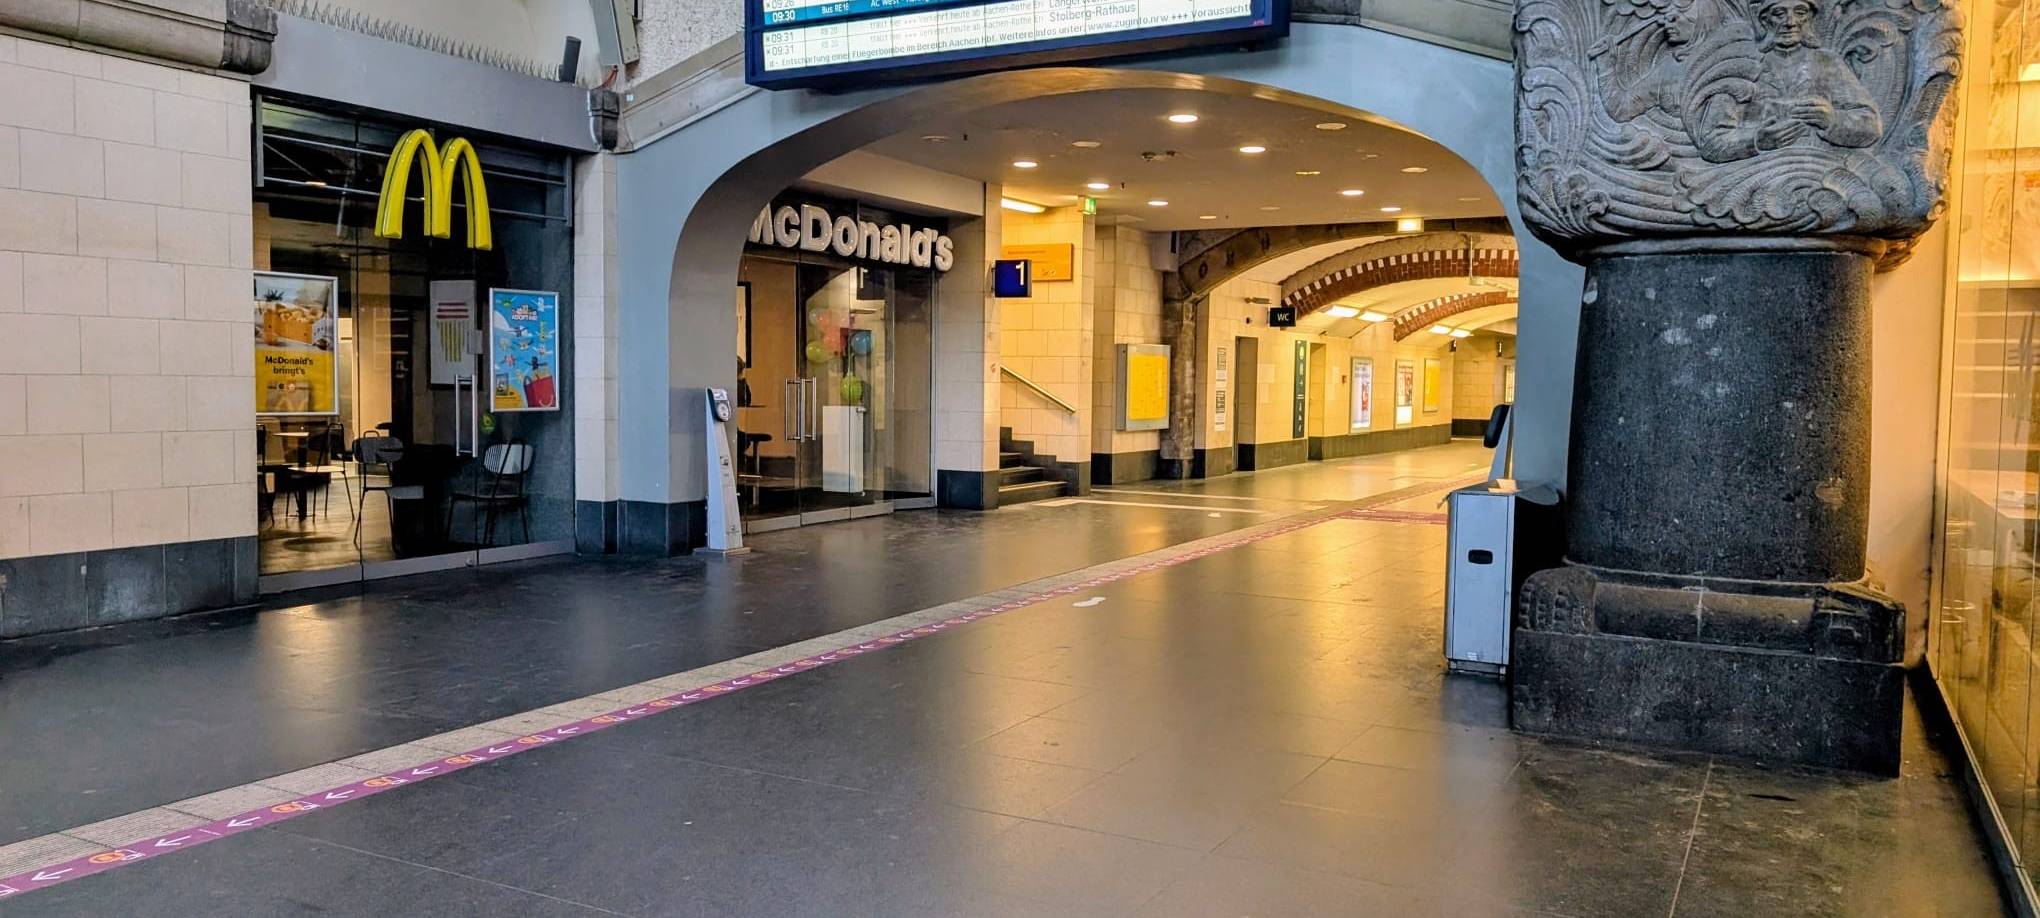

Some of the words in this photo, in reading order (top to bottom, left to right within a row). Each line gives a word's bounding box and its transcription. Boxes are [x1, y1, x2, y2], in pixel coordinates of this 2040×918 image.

[821, 6, 833, 14] Bus
[1049, 4, 1136, 22] Stolberg-Rathaus
[772, 10, 795, 22] 09:30
[771, 32, 793, 43] 09:31
[949, 37, 979, 47] Aachen
[1000, 30, 1034, 40] Weitere
[772, 45, 794, 56] 09:31
[1015, 261, 1025, 286] 1
[1277, 313, 1290, 321] WC
[265, 356, 314, 365] McDonald's
[273, 366, 306, 376] bringt's
